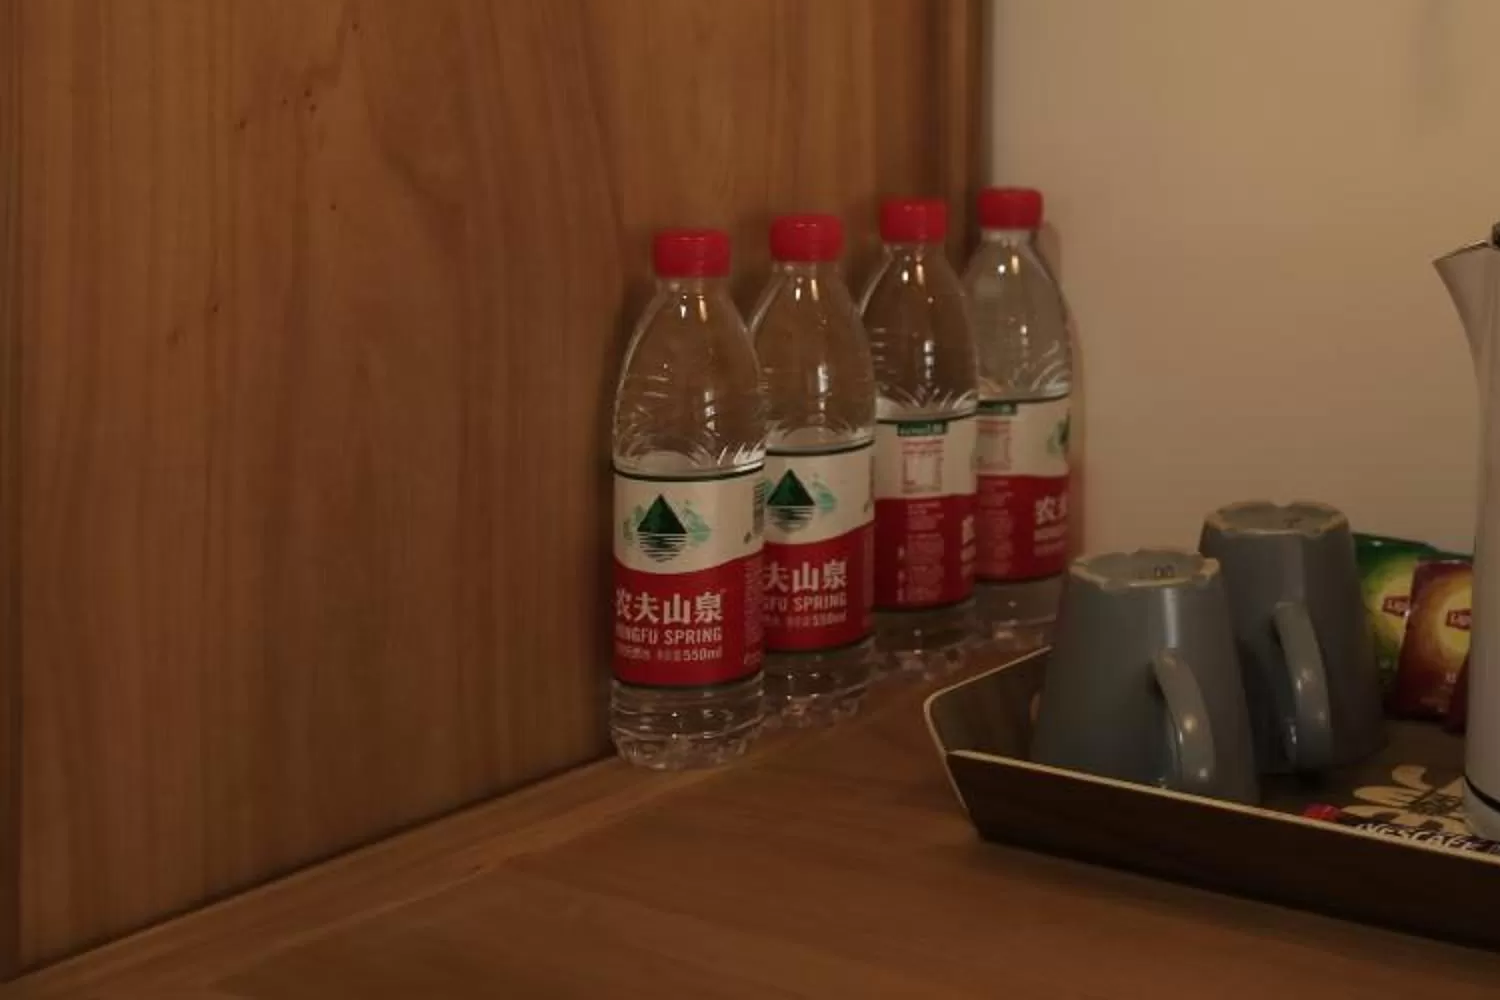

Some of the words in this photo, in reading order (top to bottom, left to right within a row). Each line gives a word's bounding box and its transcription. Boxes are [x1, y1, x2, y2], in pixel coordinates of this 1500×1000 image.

[763, 558, 848, 593] 夫山泉
[616, 587, 724, 625] 农夫山泉
[792, 591, 848, 613] SPRING
[663, 625, 723, 646] SPRING
